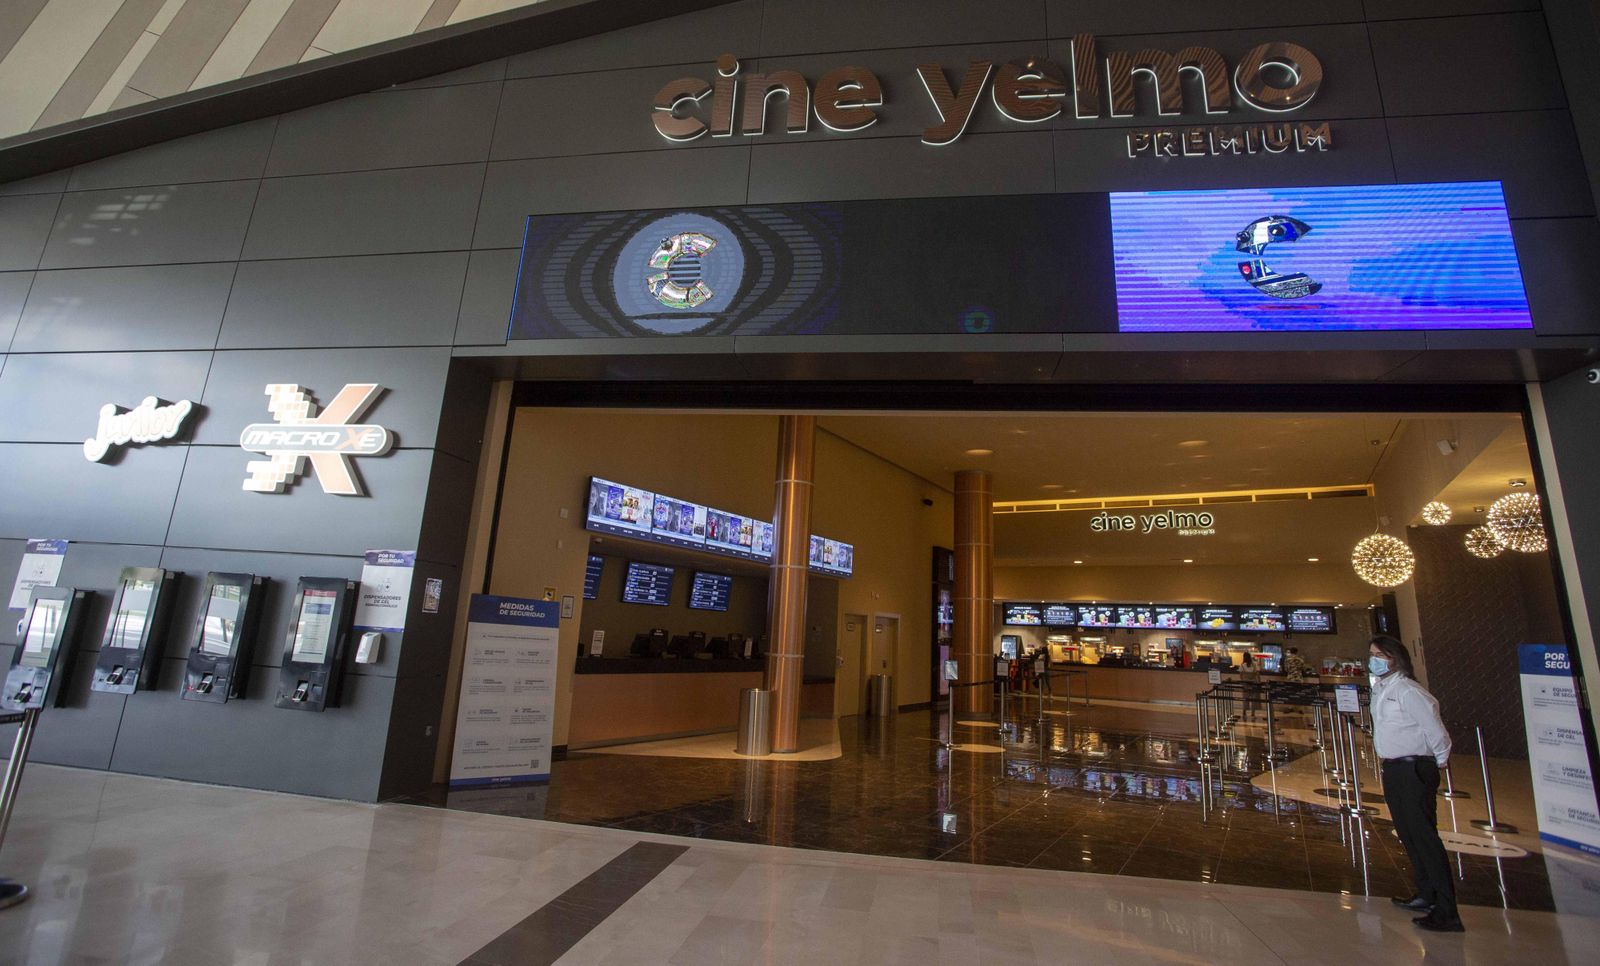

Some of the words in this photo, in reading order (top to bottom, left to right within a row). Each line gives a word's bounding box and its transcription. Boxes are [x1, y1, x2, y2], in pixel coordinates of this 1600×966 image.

[652, 53, 884, 143] cine
[916, 33, 1324, 147] yelmo
[1125, 121, 1334, 158] PREMIUM
[1090, 511, 1136, 533] cine
[1141, 509, 1214, 534] yelmo
[500, 602, 534, 611] MEDIDAS
[510, 610, 545, 618] SEGURIDAD
[1544, 652, 1565, 660] POR
